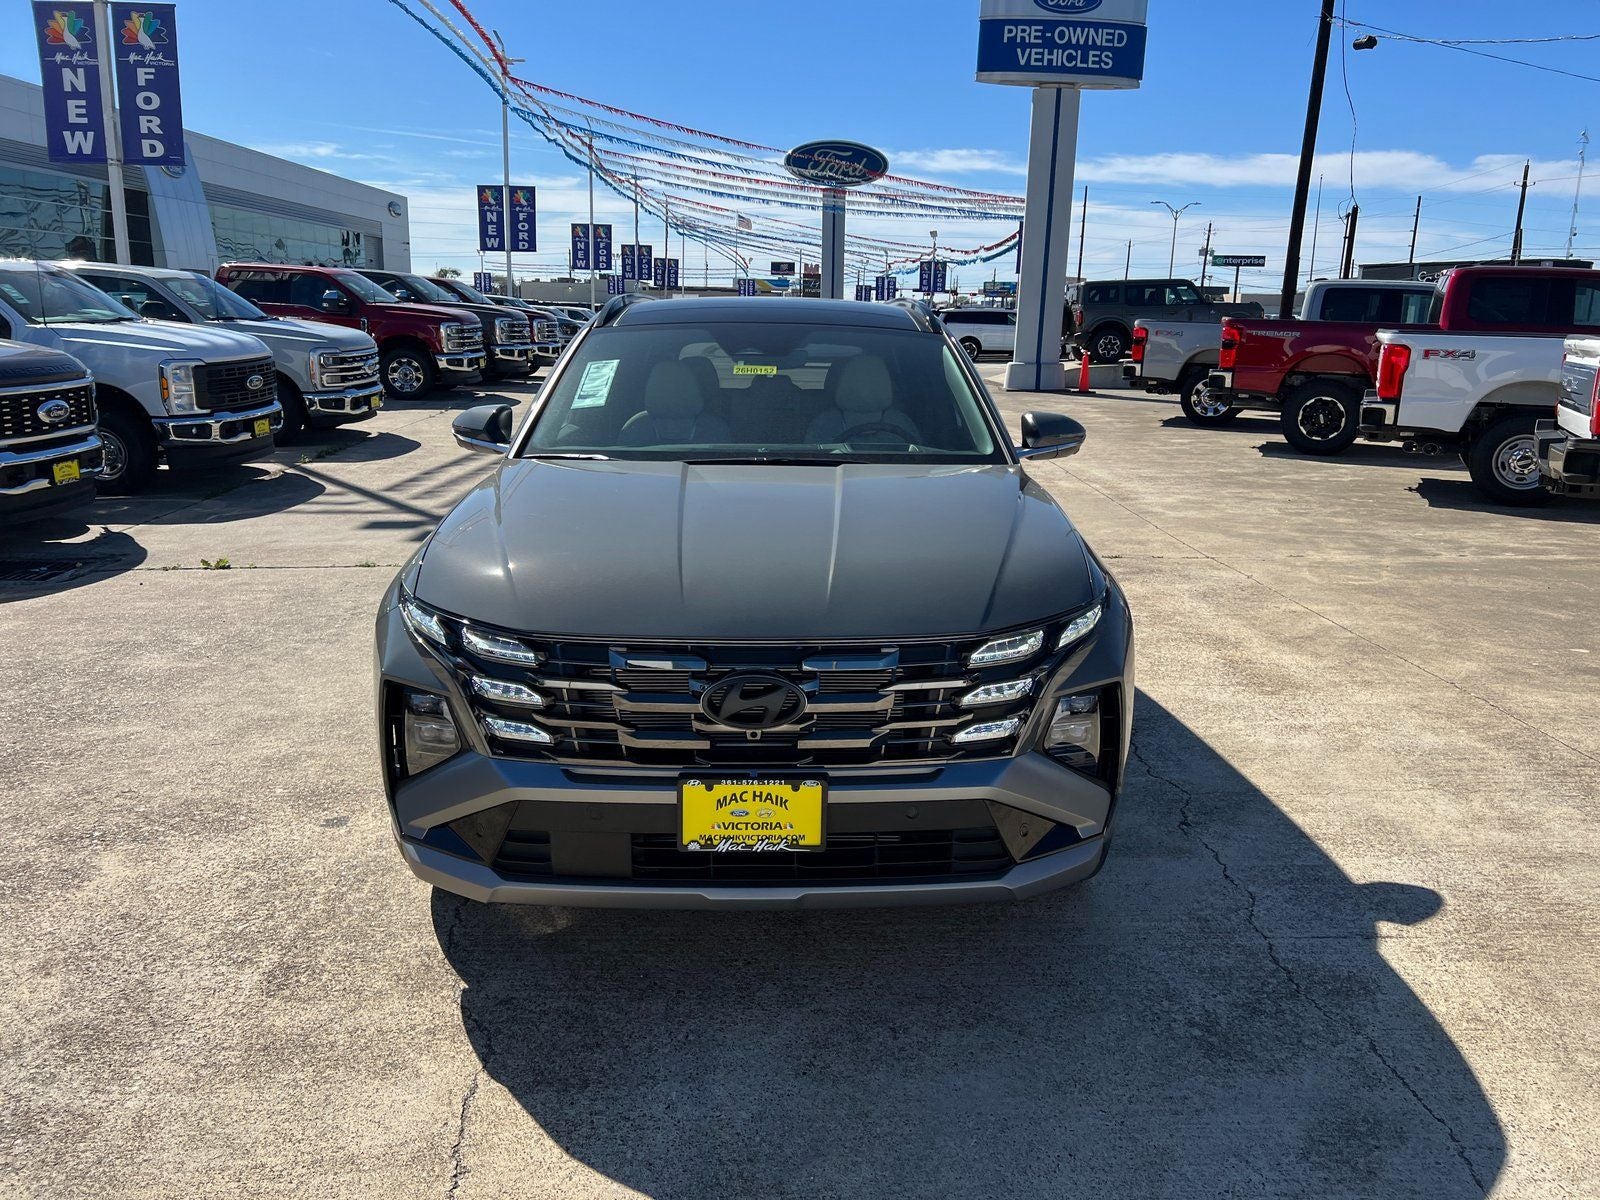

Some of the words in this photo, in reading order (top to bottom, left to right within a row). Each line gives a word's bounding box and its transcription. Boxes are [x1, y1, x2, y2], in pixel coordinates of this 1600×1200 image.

[1003, 25, 1128, 48] PRE-OWNED
[1016, 48, 1113, 69] VEHICLES
[61, 67, 95, 155] NEW
[135, 67, 165, 158] FORD
[807, 148, 868, 177] Ford
[485, 211, 500, 249] NEW
[517, 212, 529, 250] FORD
[576, 241, 586, 268] NEW
[598, 242, 607, 269] FORD
[1216, 257, 1265, 265] enterprise
[624, 258, 633, 279] NEW
[921, 273, 929, 291] NEW
[1155, 329, 1184, 337] FX4
[1250, 330, 1300, 338] TREMOR
[1422, 348, 1476, 360] FX4
[715, 790, 749, 811] MAC
[752, 790, 789, 811] HAIK
[721, 821, 783, 831] VICTORIA
[715, 838, 747, 853] Mac
[752, 838, 790, 853] Haik
